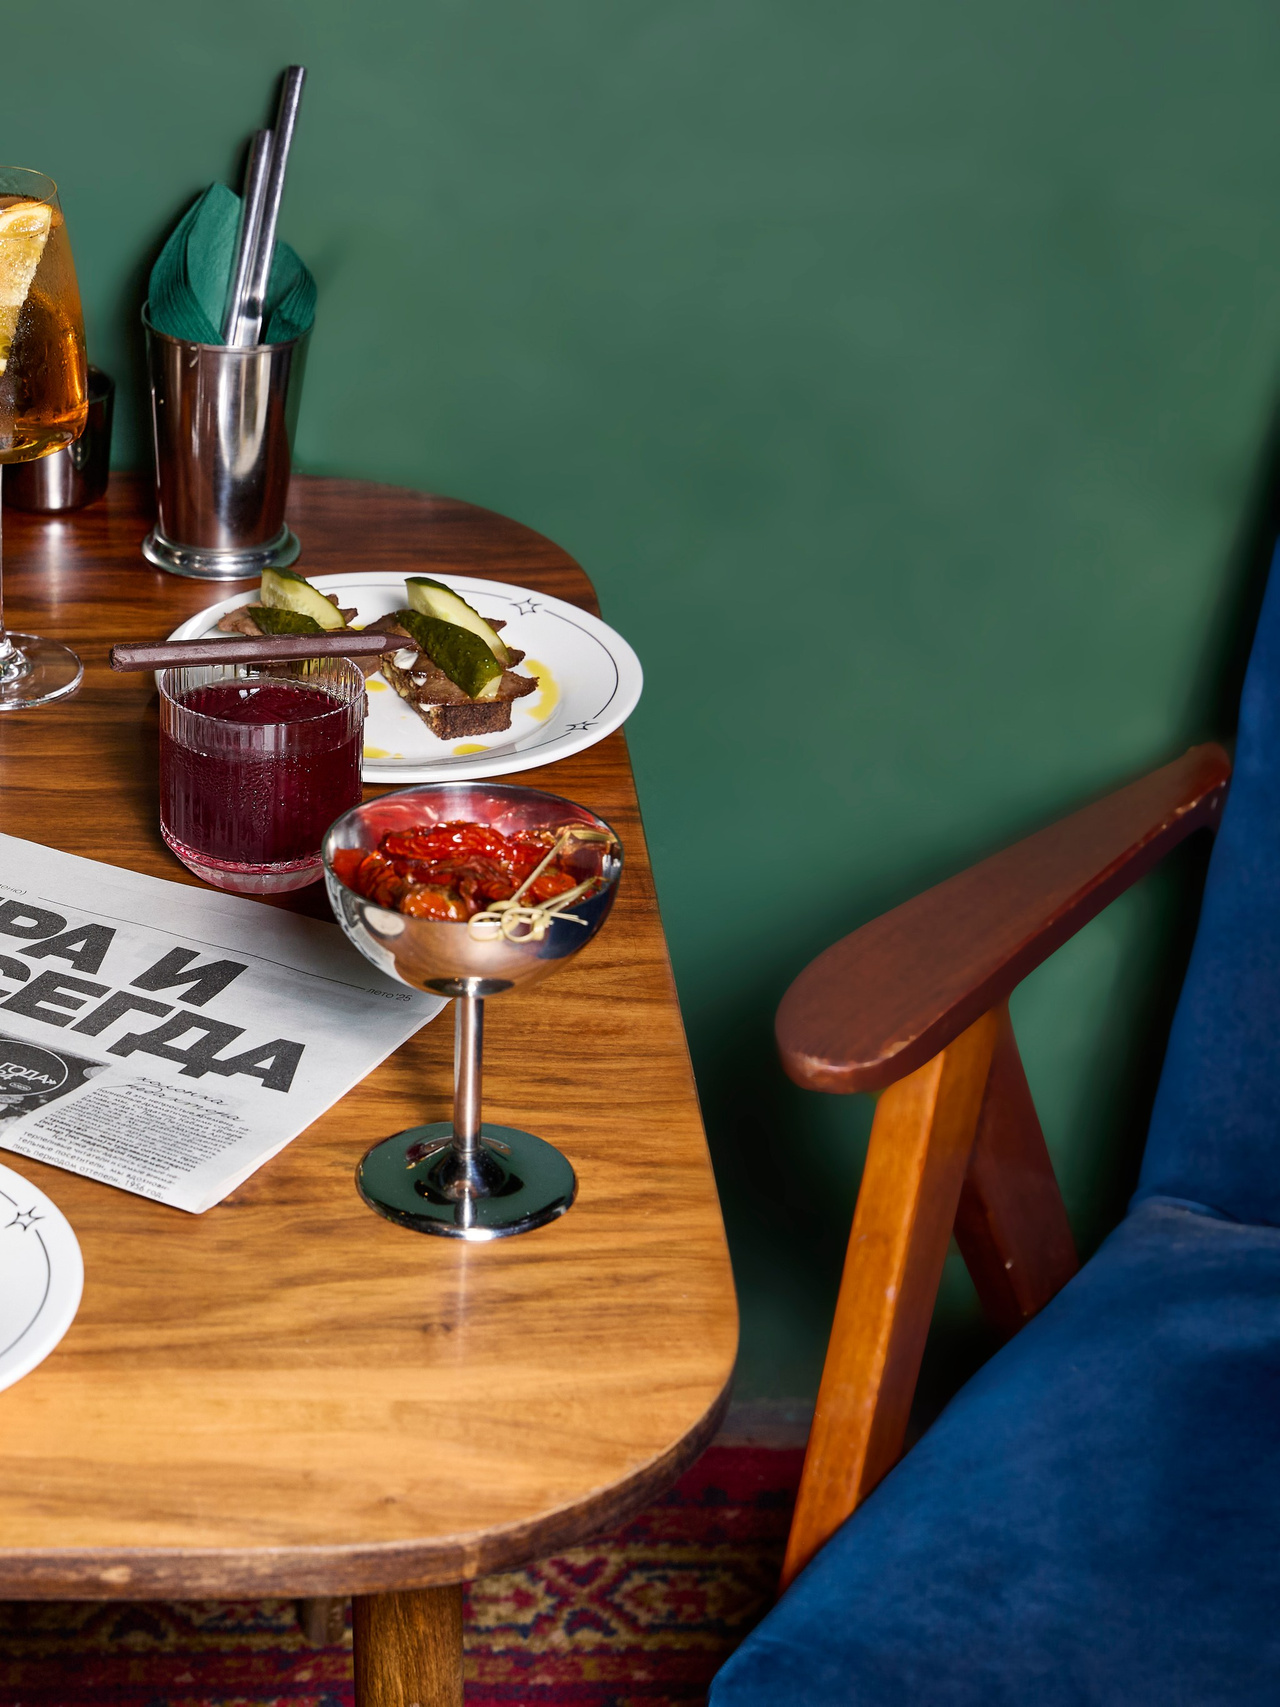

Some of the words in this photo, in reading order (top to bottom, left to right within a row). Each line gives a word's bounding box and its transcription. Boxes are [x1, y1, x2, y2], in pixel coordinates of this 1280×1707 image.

[129, 946, 249, 1007] И
[365, 988, 394, 999] лето
[132, 1103, 175, 1120] создатели
[17, 1136, 53, 1151] тельные
[55, 1149, 107, 1170] посетители,
[23, 1131, 72, 1150] терпеливые
[73, 1148, 109, 1162] читатели
[12, 1143, 32, 1153] лись
[31, 1150, 77, 1170] периодом
[124, 1179, 146, 1191] 1956
